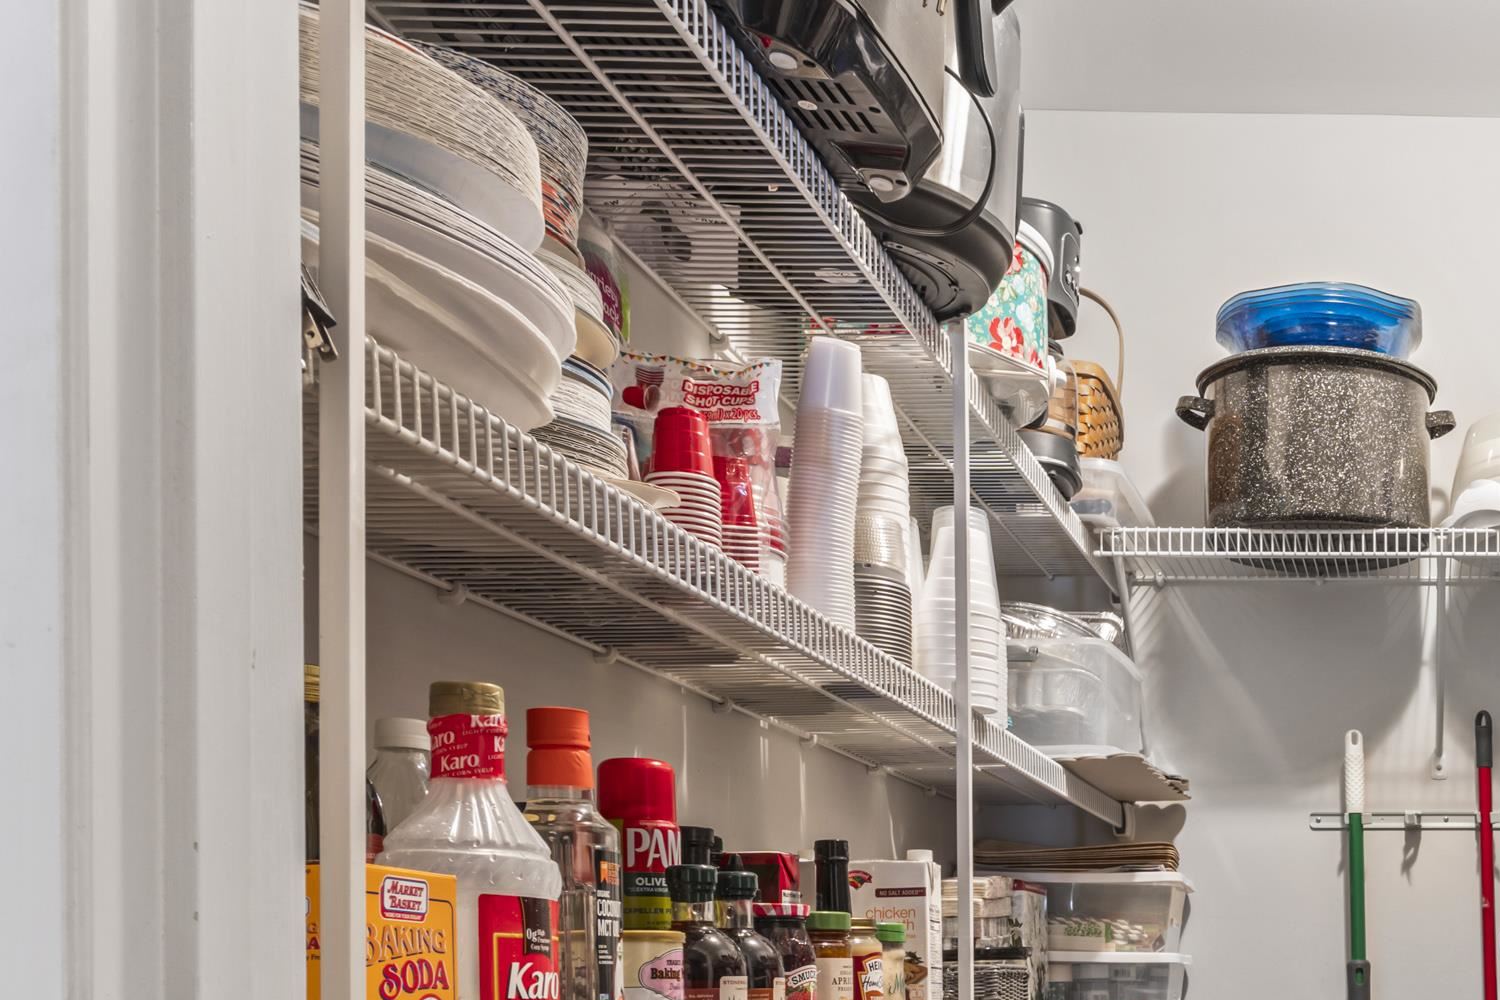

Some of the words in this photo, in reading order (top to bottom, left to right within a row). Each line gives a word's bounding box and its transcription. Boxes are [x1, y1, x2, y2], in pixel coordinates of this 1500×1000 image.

[683, 380, 759, 396] DISPOSABLE
[686, 394, 719, 407] SHOT
[720, 394, 755, 406] CUPS
[440, 754, 480, 772] Karo
[626, 827, 682, 868] PAM
[387, 880, 424, 898] MARKET
[636, 877, 668, 886] OLIVE
[390, 895, 422, 912] BASKET
[866, 906, 916, 920] chicken
[598, 918, 612, 936] MCT
[508, 961, 560, 1000] Karo
[650, 968, 682, 981] Baking
